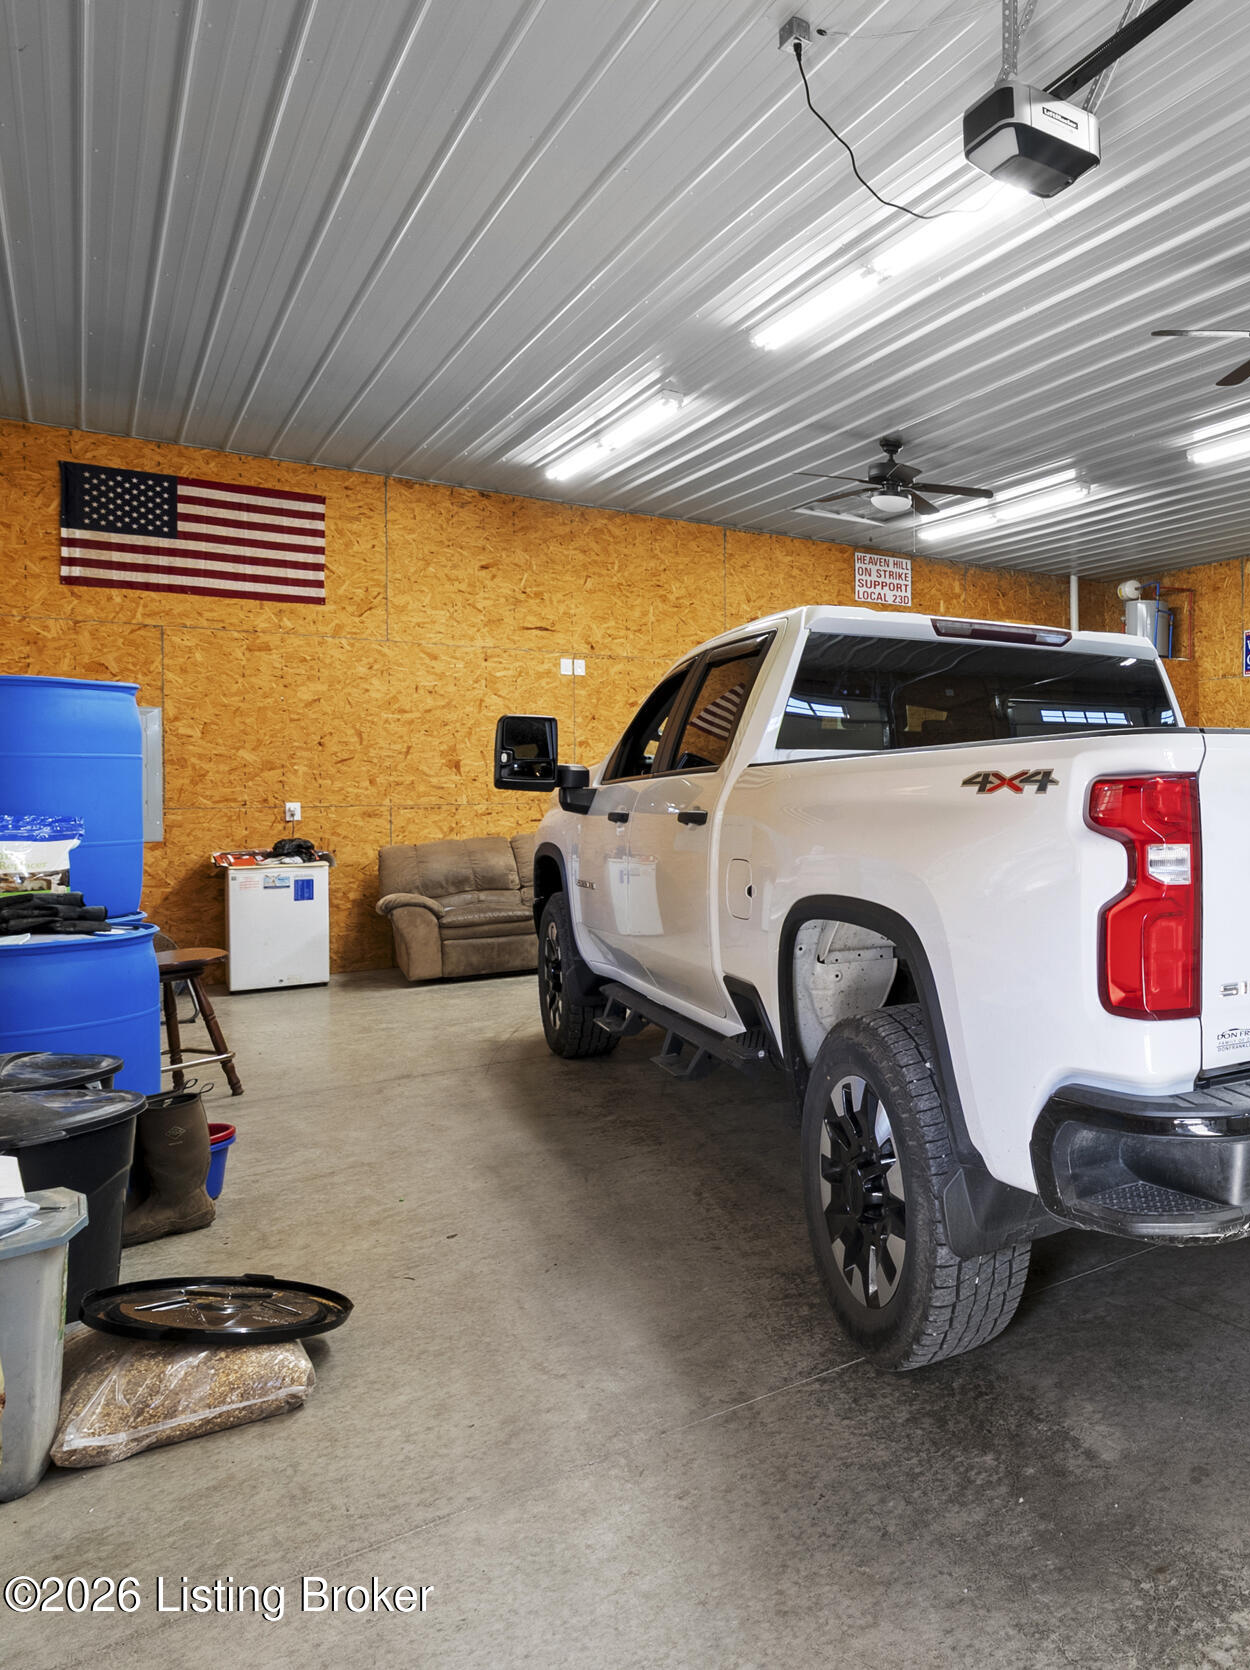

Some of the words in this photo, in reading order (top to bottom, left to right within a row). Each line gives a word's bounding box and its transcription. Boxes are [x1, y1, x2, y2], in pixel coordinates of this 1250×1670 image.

[856, 554, 890, 568] HEAVEN
[893, 560, 910, 571] HILL
[857, 566, 872, 577] ON
[876, 569, 910, 582] STRIKE
[857, 578, 909, 593] SUPPORT
[857, 590, 889, 602] LOCAL
[892, 594, 910, 605] 23D
[1216, 1031, 1238, 1041] DON
